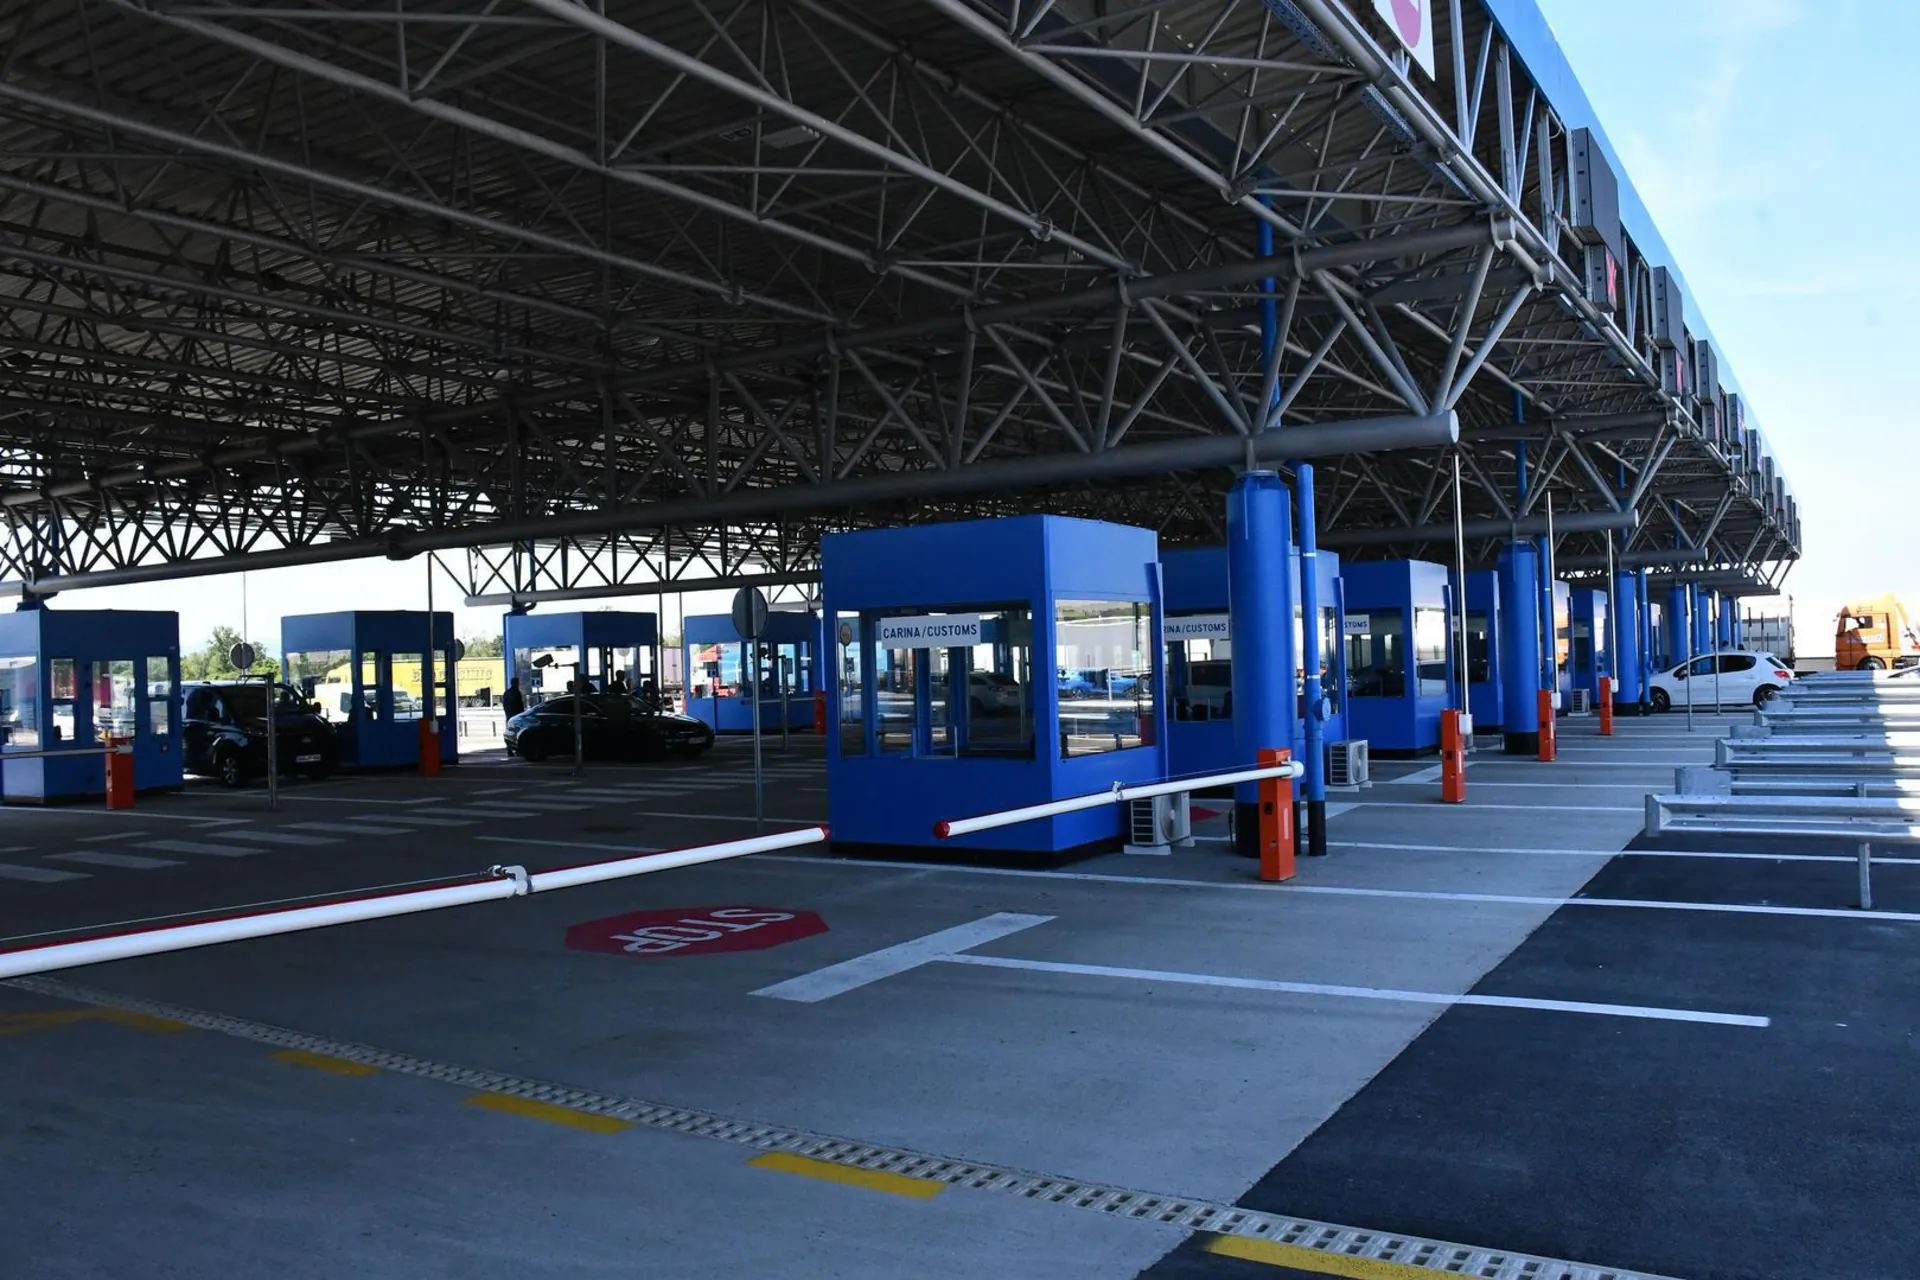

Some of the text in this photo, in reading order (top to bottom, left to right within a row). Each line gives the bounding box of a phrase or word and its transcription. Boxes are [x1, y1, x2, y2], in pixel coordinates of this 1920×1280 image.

[883, 624, 977, 639] CARINA/CUSTOMS
[1163, 623, 1226, 634] RINA/CUSTOMS
[609, 908, 796, 953] STOP
